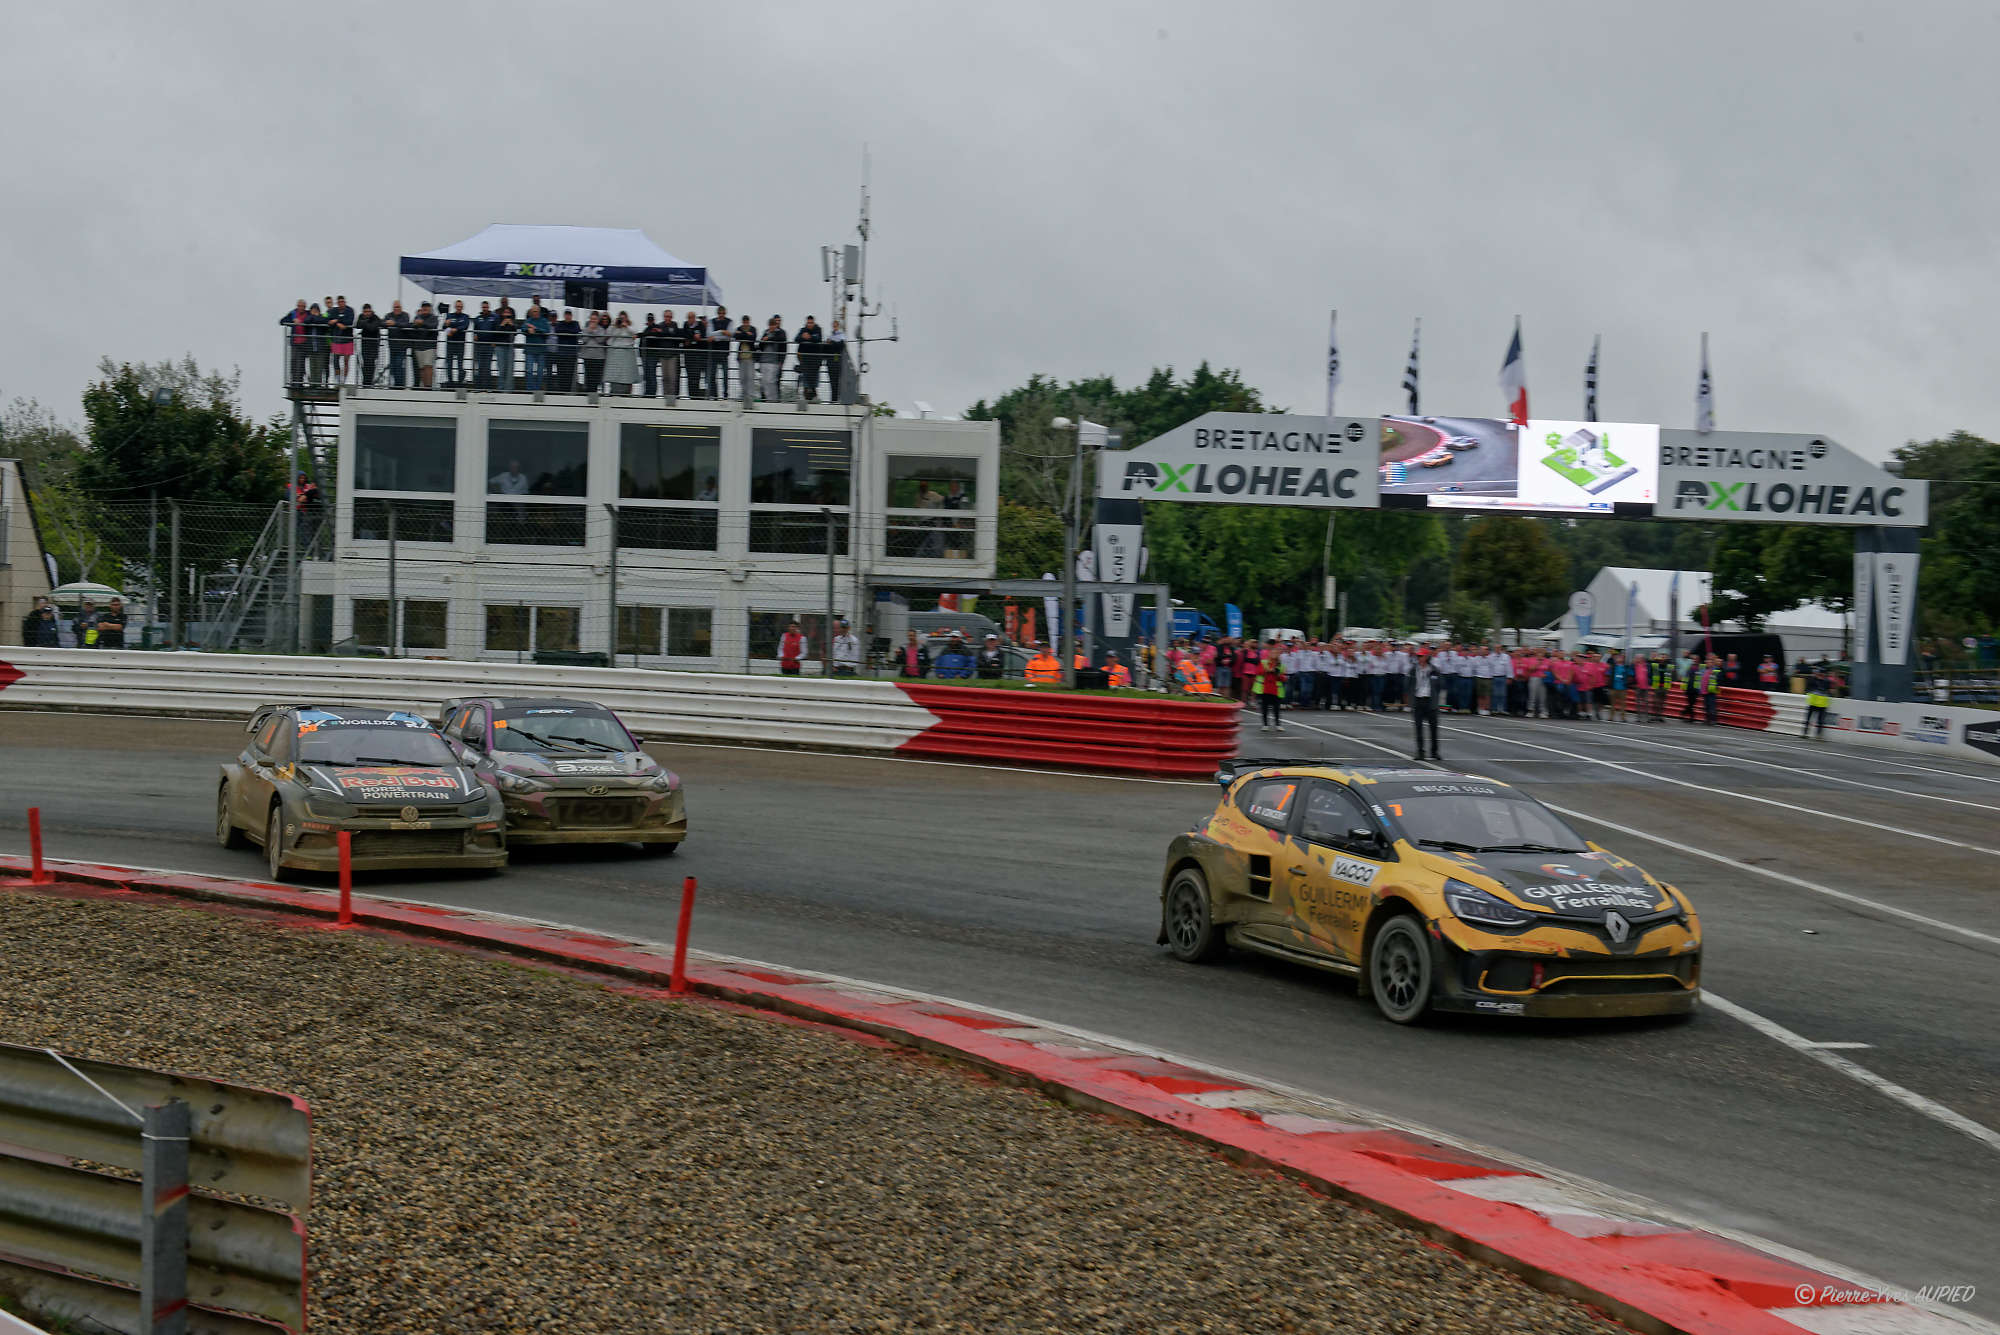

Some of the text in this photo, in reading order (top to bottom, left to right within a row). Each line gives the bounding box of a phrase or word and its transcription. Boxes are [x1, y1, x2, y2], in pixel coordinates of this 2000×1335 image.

[1195, 428, 1343, 454] BRETAGNE
[1660, 446, 1805, 471] BRETAGNE
[339, 776, 459, 789] Red Bull
[363, 792, 450, 800] POWERTRAIN
[1334, 860, 1375, 883] YACCO
[1524, 883, 1655, 898] GUILLERME
[1552, 894, 1654, 910] Ferrailles
